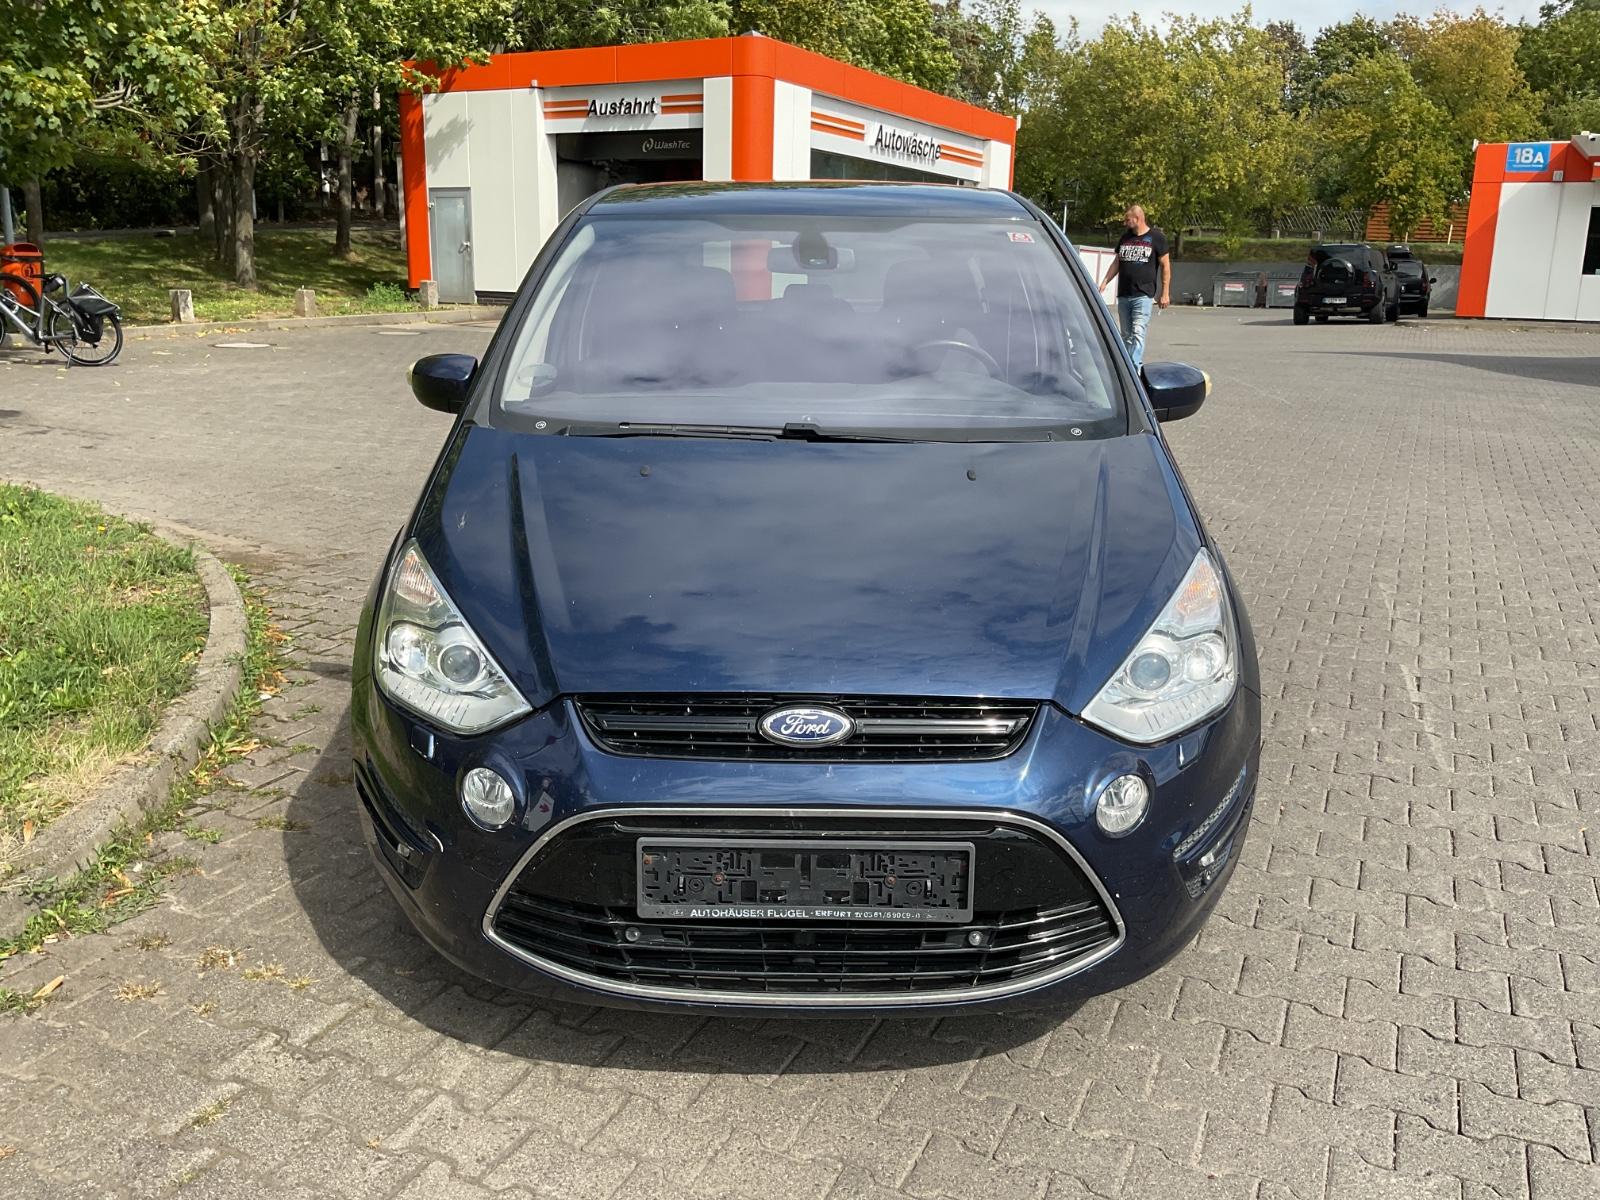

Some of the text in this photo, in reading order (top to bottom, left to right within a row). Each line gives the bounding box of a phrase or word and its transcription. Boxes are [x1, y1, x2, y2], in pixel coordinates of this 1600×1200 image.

[587, 97, 656, 117] Ausfahrt
[874, 124, 942, 160] Autowäsche
[780, 714, 831, 735] Ford
[690, 908, 764, 918] AUTOHÄUSER
[815, 910, 851, 918] ERFURT
